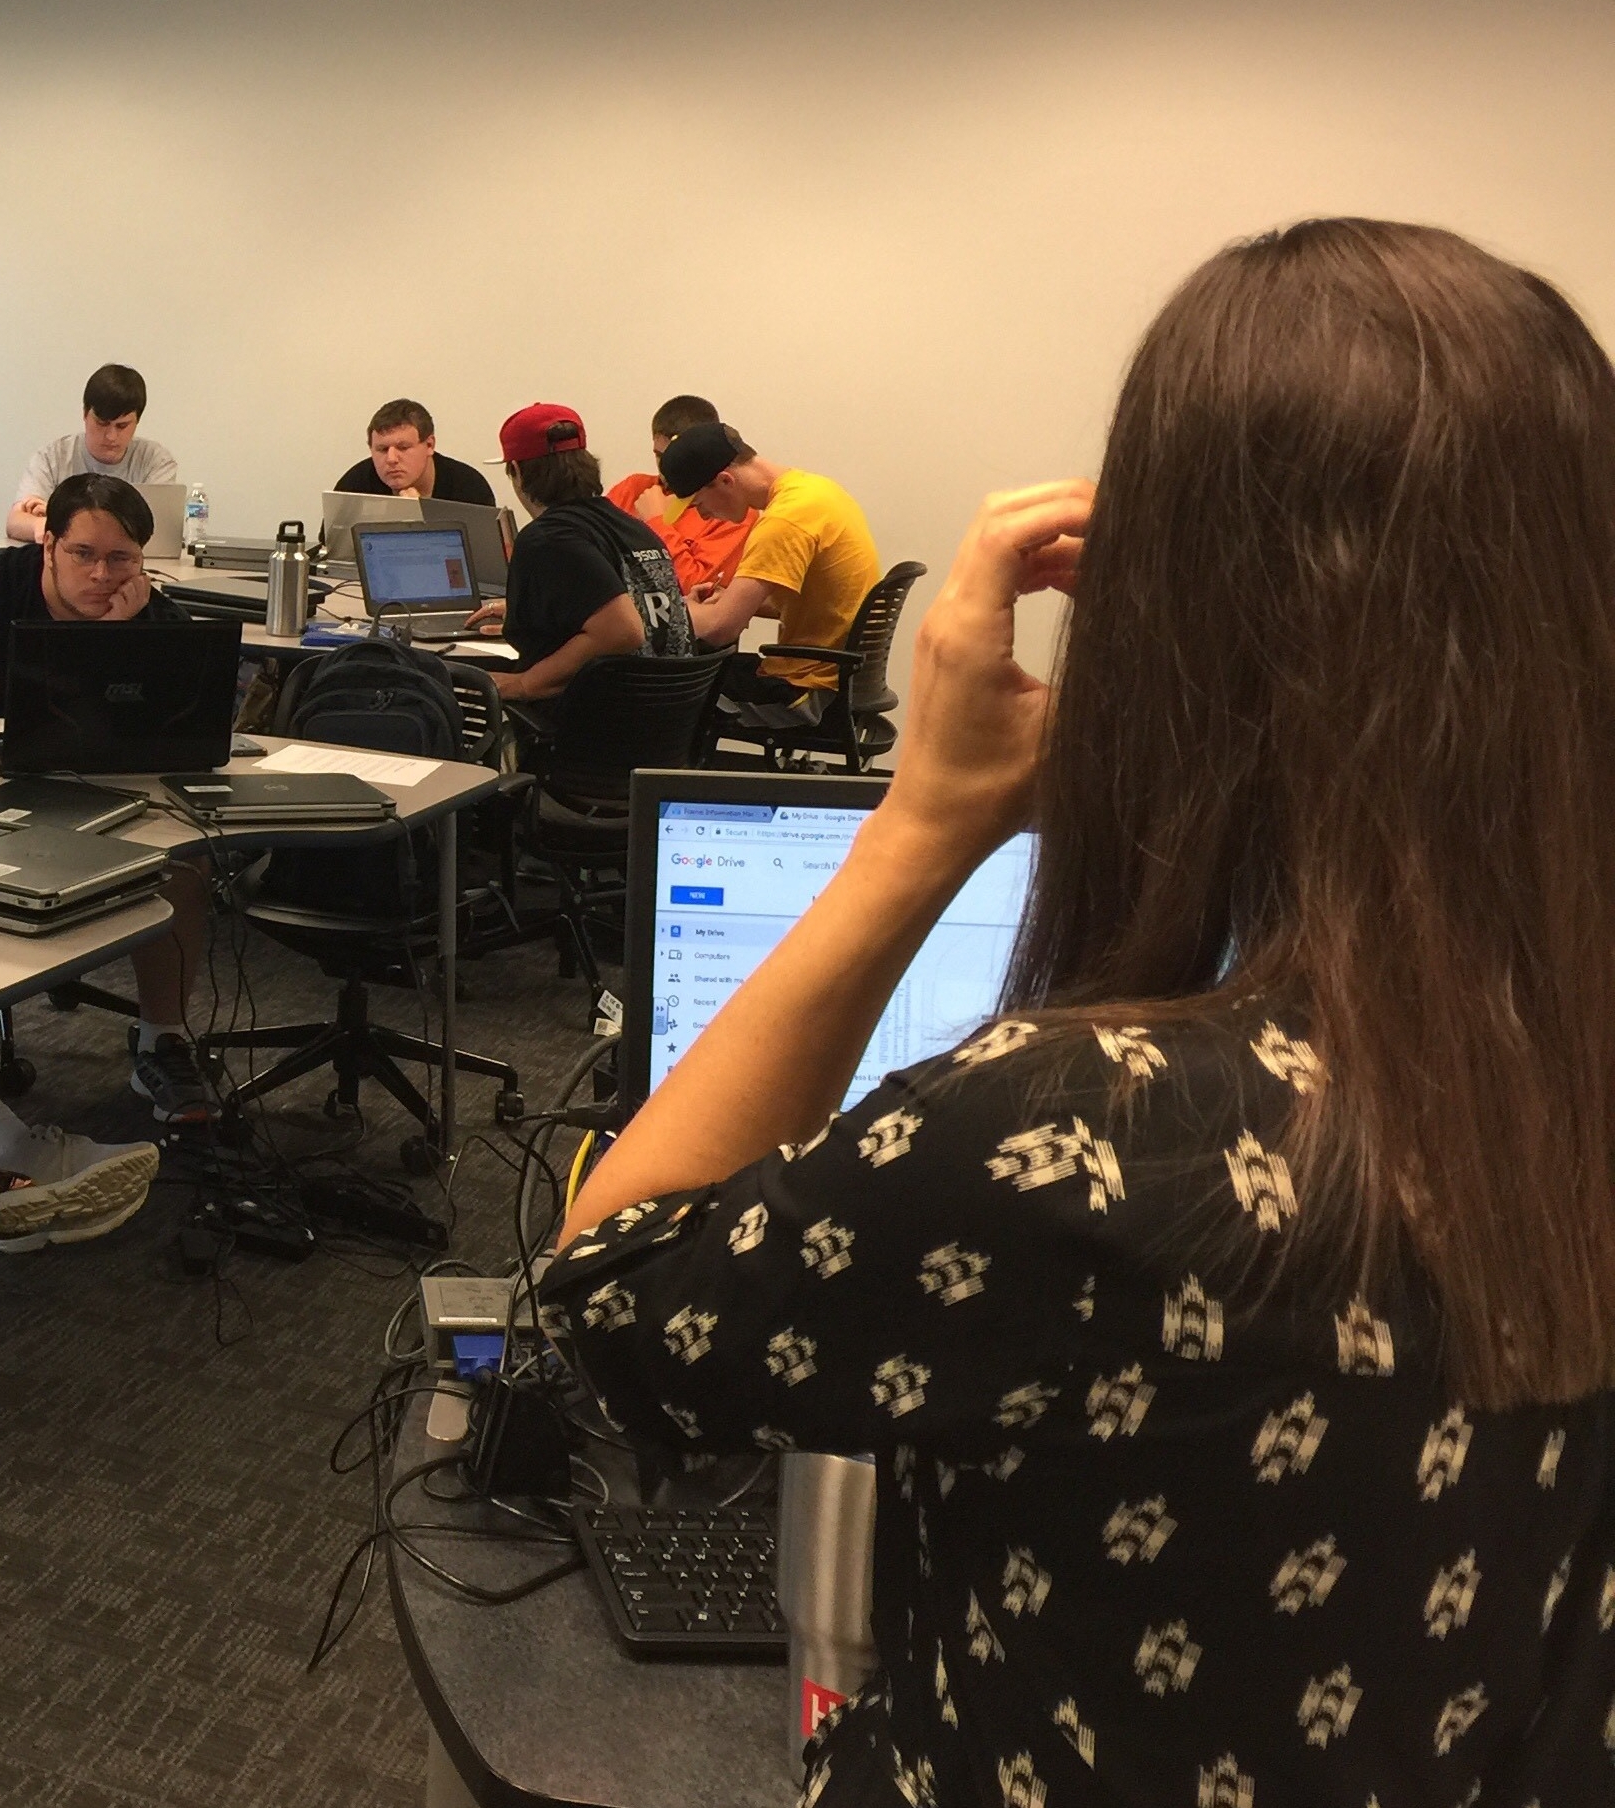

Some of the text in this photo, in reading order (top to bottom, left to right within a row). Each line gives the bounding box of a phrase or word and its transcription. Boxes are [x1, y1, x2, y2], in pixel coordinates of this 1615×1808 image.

[643, 591, 671, 629] R
[824, 813, 845, 823] Google
[671, 853, 713, 868] Google
[717, 856, 746, 868] Drive
[803, 861, 831, 870] Search
[695, 929, 706, 938] My
[694, 952, 731, 961] Computers
[693, 998, 717, 1006] Recent
